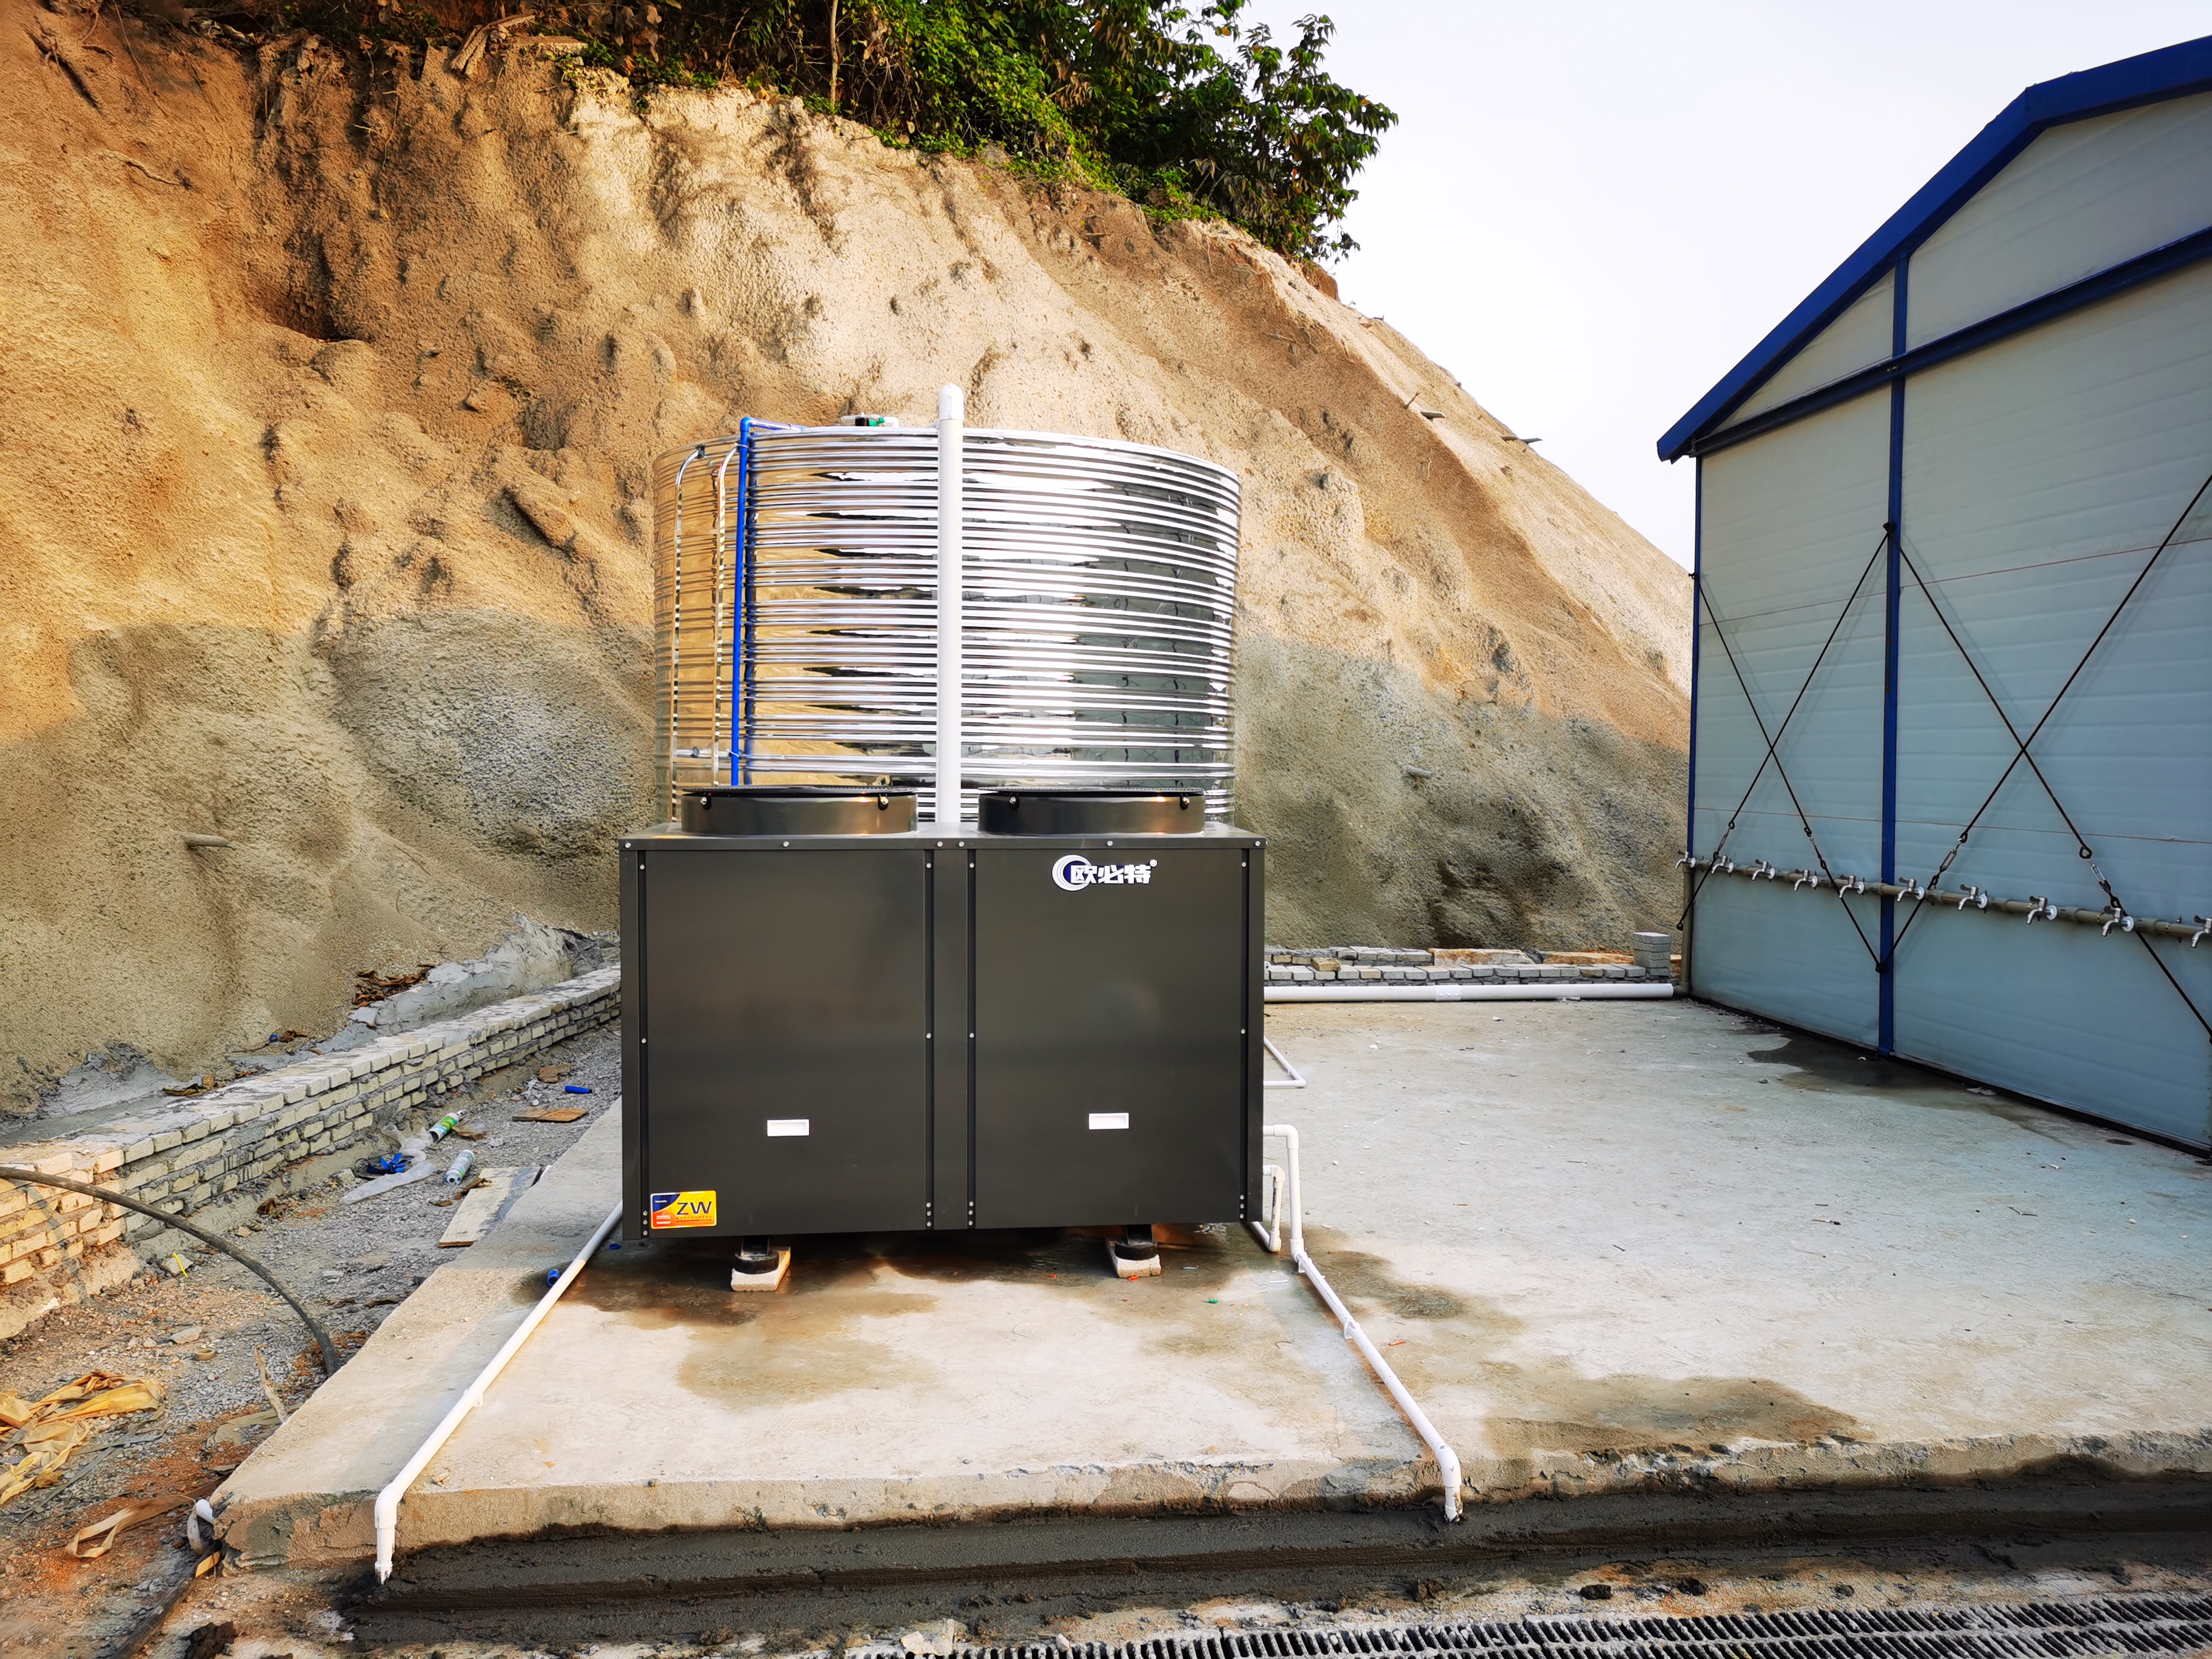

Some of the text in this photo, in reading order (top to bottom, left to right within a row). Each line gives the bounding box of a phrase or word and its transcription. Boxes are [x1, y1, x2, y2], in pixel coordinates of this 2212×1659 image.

[1070, 864, 1151, 884] 欧必特
[676, 1201, 712, 1215] ZW
